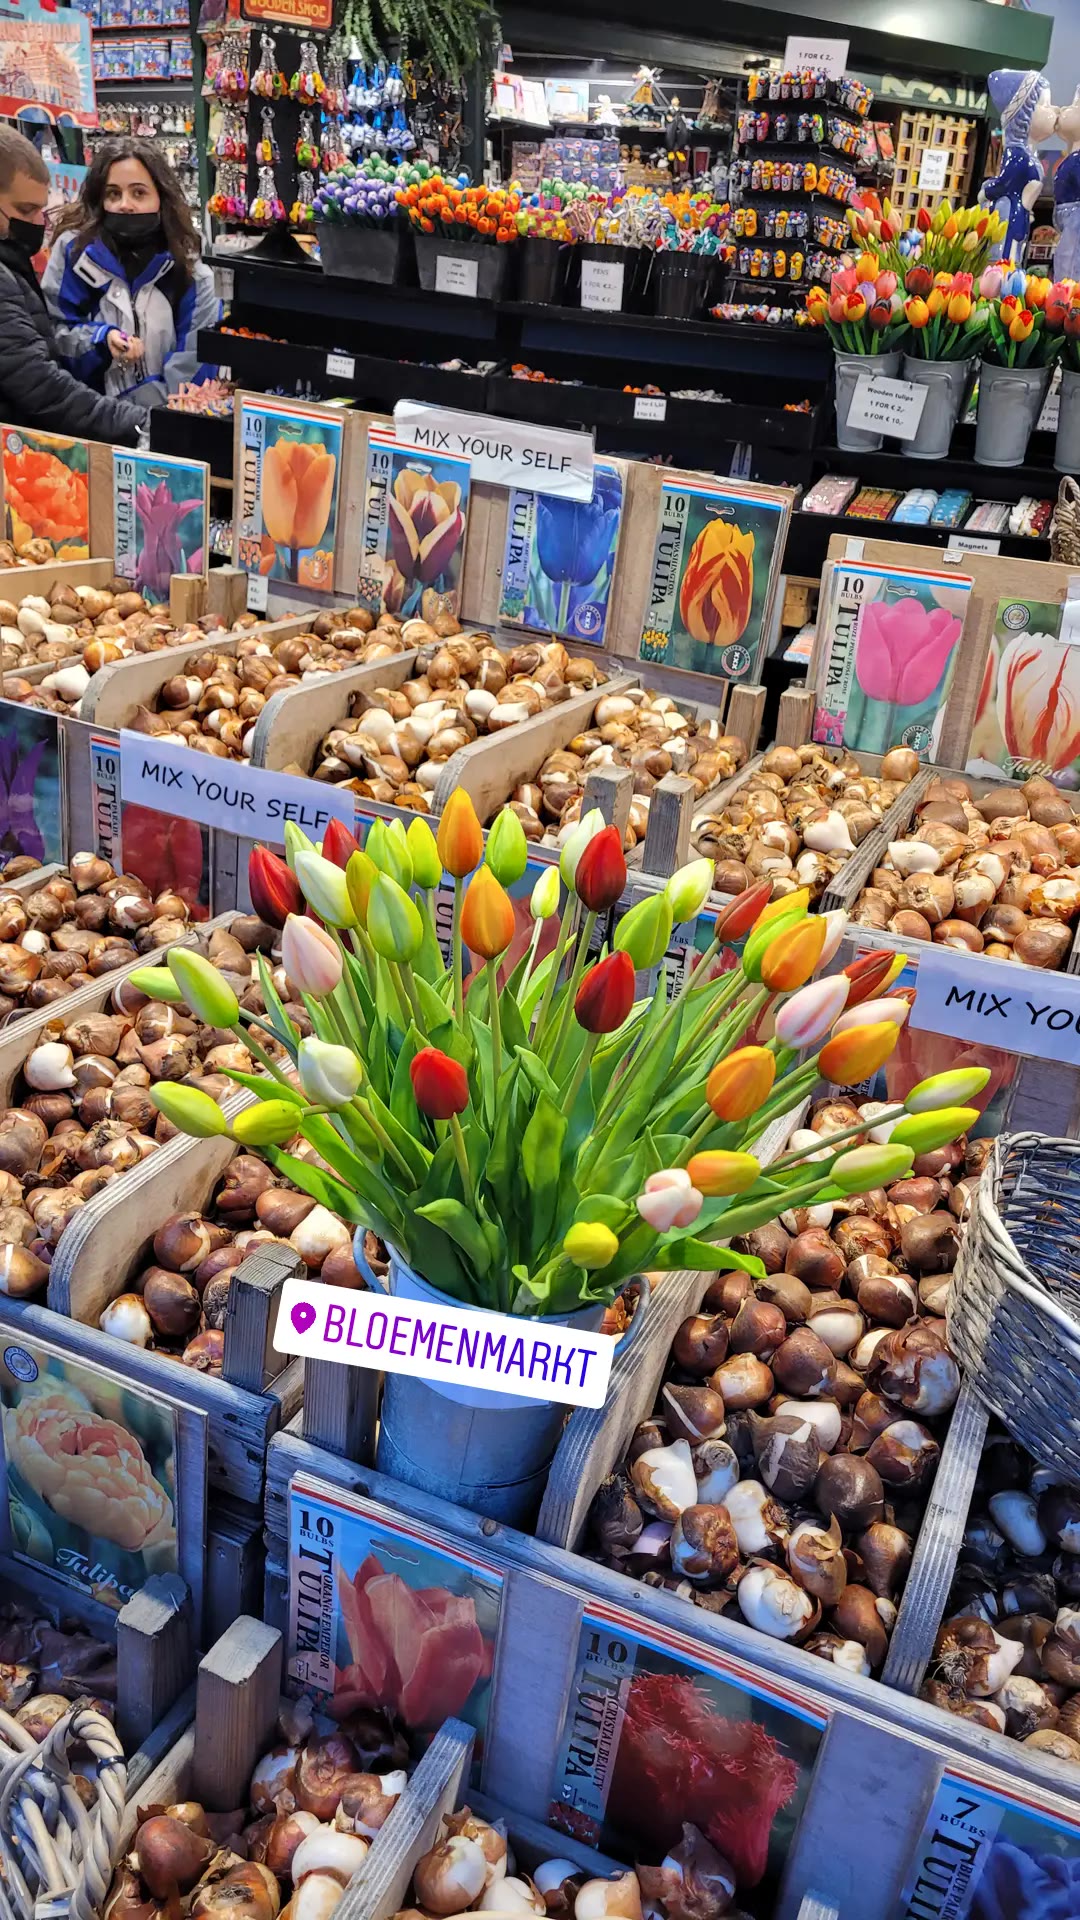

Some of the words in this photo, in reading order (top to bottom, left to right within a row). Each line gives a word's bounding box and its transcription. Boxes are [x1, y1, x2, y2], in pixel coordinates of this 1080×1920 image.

[297, 3, 328, 18] SHOE
[804, 52, 818, 60] FOR
[867, 387, 894, 398] Wooden
[895, 392, 914, 402] tulips
[875, 401, 889, 409] FOR
[246, 417, 262, 433] 10
[870, 413, 884, 421] FOR
[371, 453, 389, 465] 10
[414, 427, 450, 449] MIX
[457, 434, 513, 462] YOUR
[521, 449, 572, 472] SELF
[117, 461, 132, 476] 10
[243, 440, 262, 519] TULIPA
[365, 477, 388, 556] TULIPA
[664, 510, 685, 519] BULBS
[665, 495, 685, 512] 10
[117, 484, 133, 556] TULIPA
[508, 490, 534, 566] TULIPA
[958, 542, 988, 550] Magnets
[651, 519, 683, 606] TULIPA
[667, 540, 681, 597] WASHINGTON
[840, 591, 863, 600] BULBS
[842, 576, 864, 594] 10
[826, 602, 861, 688] TULIPA
[96, 756, 115, 775] 10
[1002, 755, 1066, 782] Tulipa
[141, 760, 183, 788] MIX
[191, 774, 256, 812] YOUR
[265, 799, 329, 829] SELF
[97, 783, 116, 861] TULIP
[111, 804, 119, 837] PARADE
[945, 985, 1012, 1018] MIX
[1025, 1001, 1080, 1035] YO
[299, 1509, 335, 1538] 10
[300, 1529, 334, 1547] BULBS
[55, 1548, 135, 1597] Tulipa
[296, 1543, 334, 1653] TULIPA
[321, 1573, 333, 1618] ORANGE
[319, 1618, 331, 1669] EMPEROR
[587, 1632, 628, 1663] 10
[586, 1652, 626, 1673] BULBS
[565, 1668, 621, 1778] TULIPA
[602, 1699, 619, 1748] CRYSTAL
[592, 1748, 610, 1791] BEAUTY
[954, 1797, 980, 1819] 7
[940, 1813, 986, 1838] BULBS
[950, 1861, 973, 1894] BLUE
